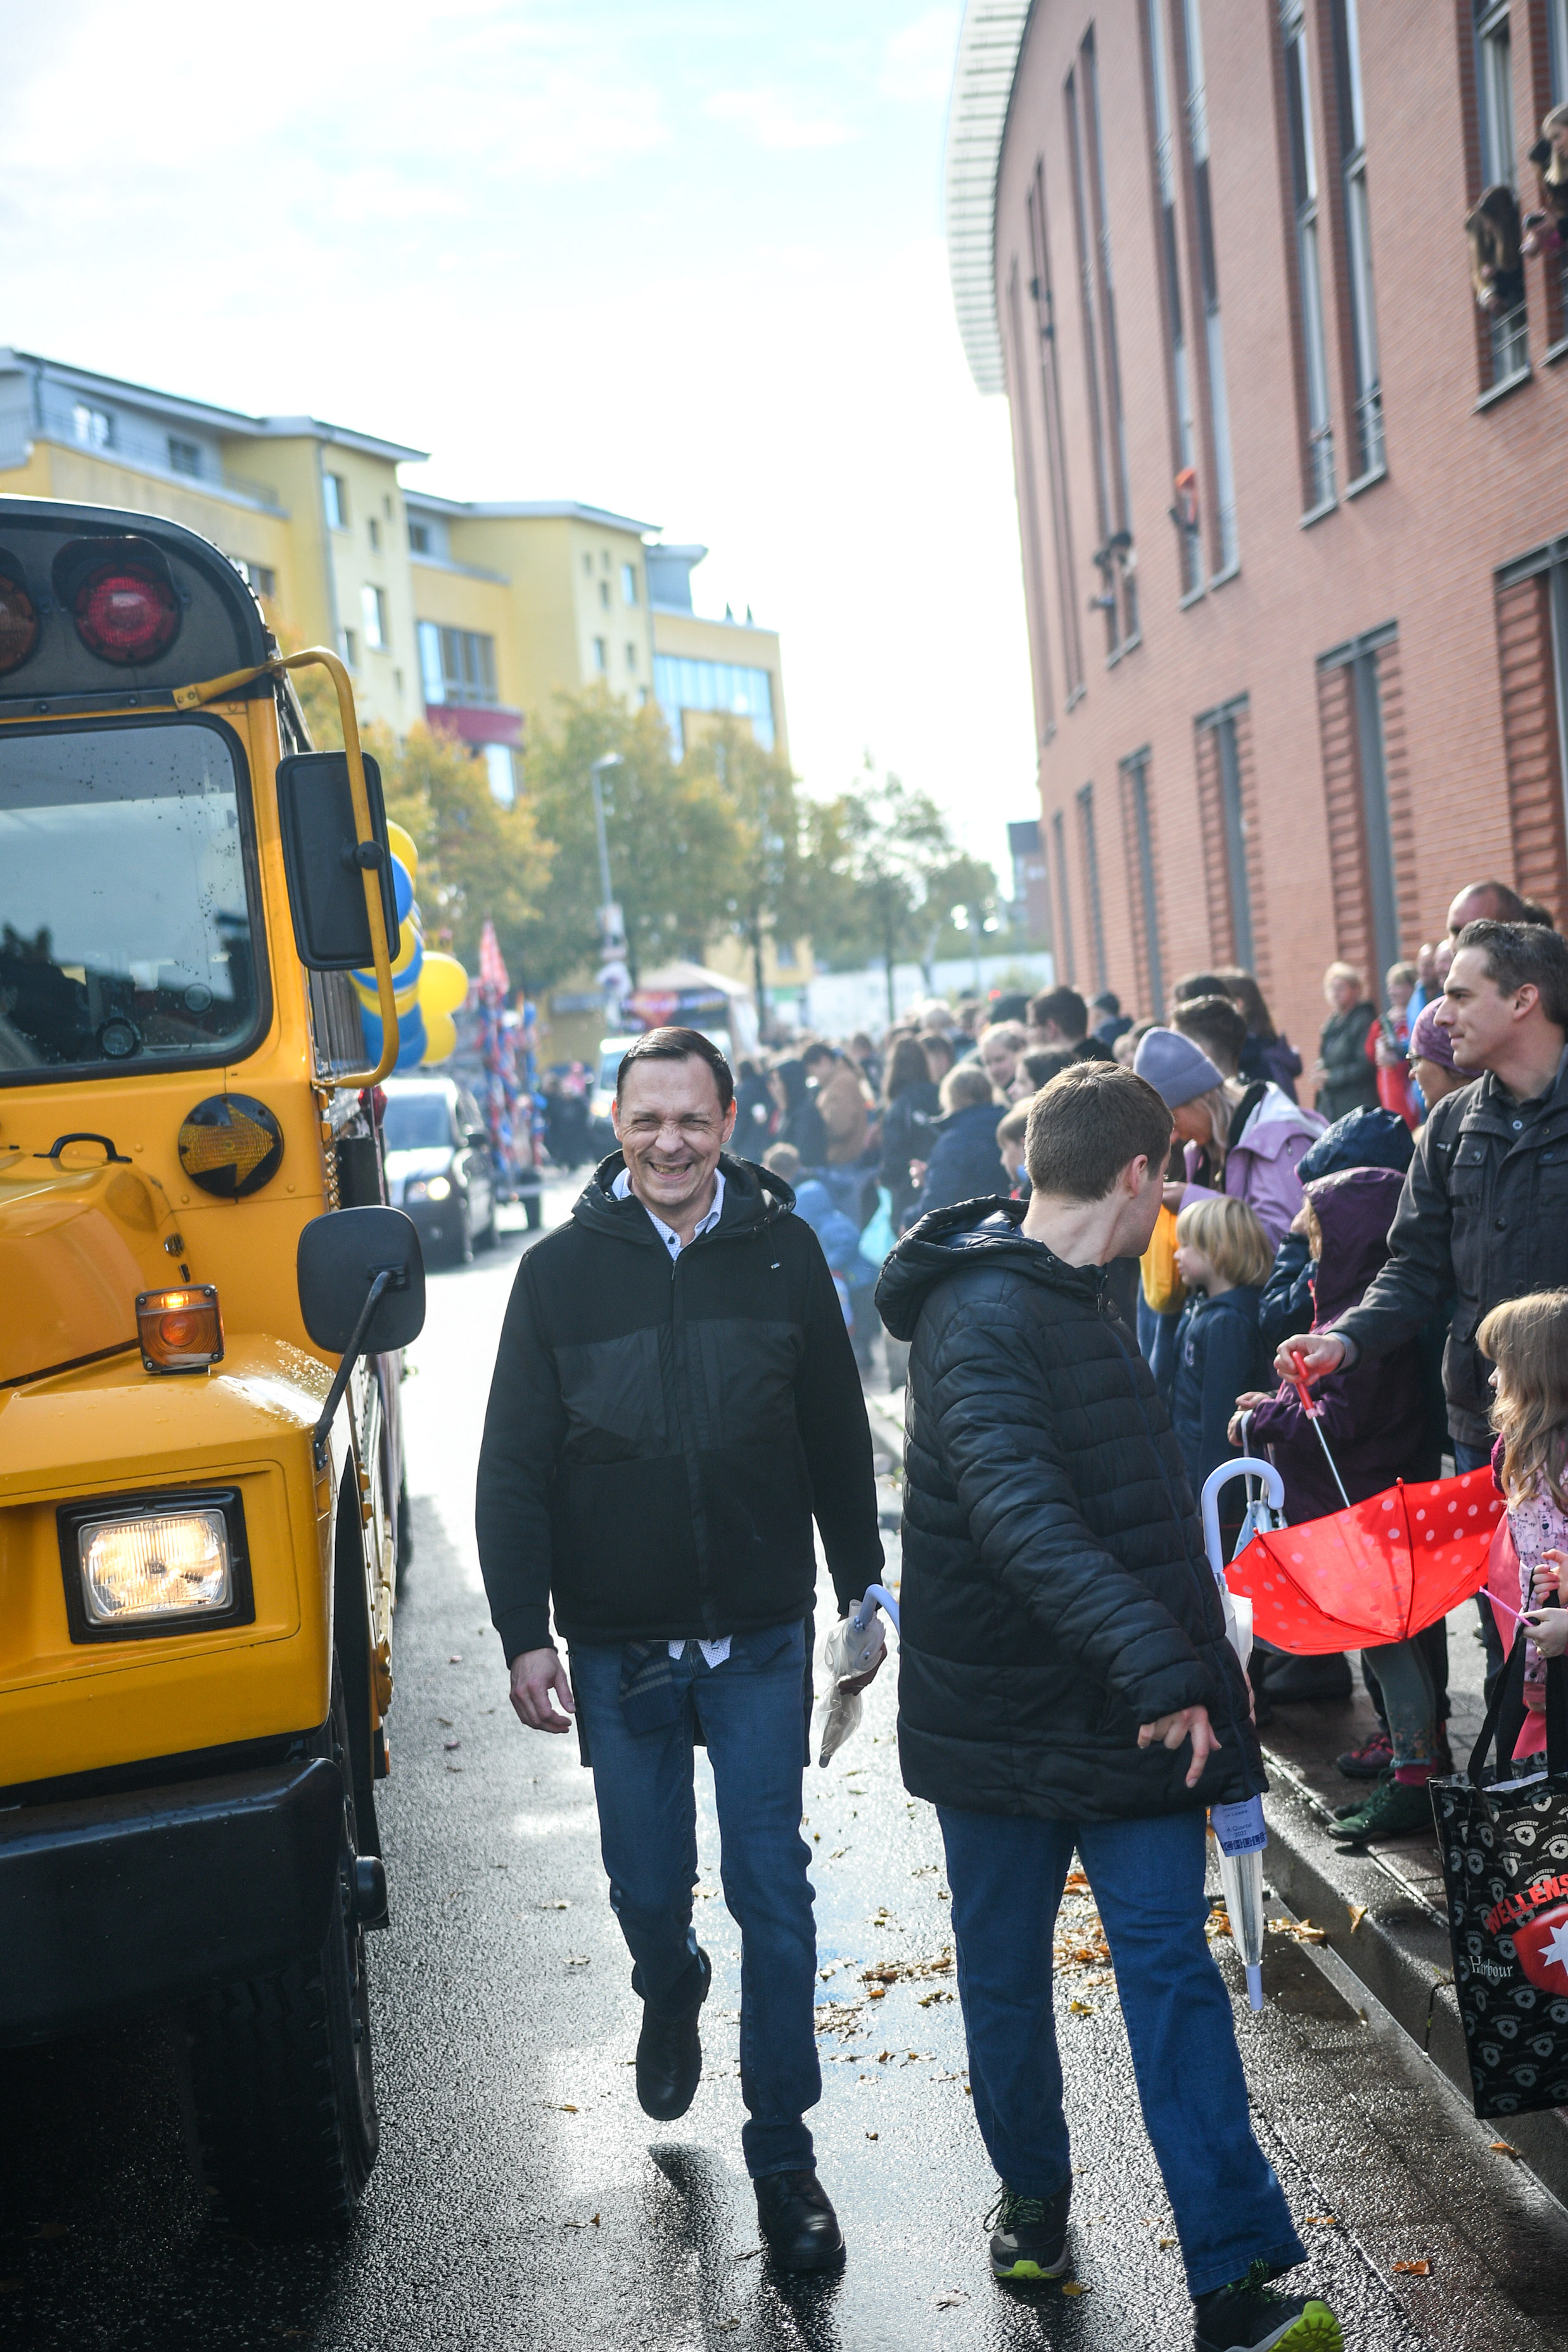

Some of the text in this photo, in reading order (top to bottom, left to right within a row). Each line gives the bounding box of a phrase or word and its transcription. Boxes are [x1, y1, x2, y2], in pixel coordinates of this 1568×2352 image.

[150, 1564, 162, 1572] H4
[1232, 1822, 1252, 1831] Quartal
[1469, 1956, 1513, 1977] Harbour
